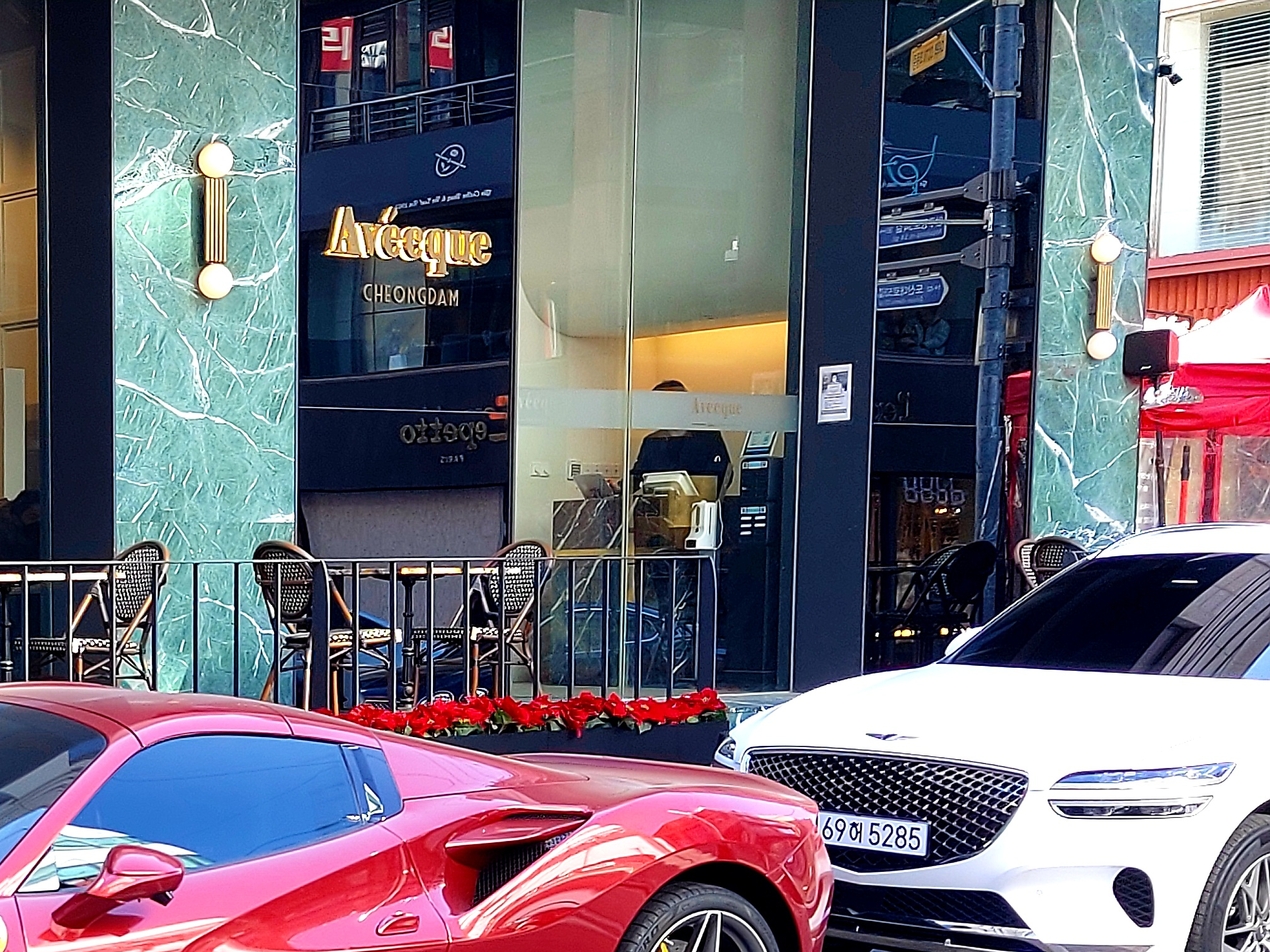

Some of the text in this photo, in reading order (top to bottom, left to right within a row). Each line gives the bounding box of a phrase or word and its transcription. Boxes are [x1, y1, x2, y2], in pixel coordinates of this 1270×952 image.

[362, 283, 459, 307] CHEONGDAM
[822, 816, 921, 851] 69허 5285
